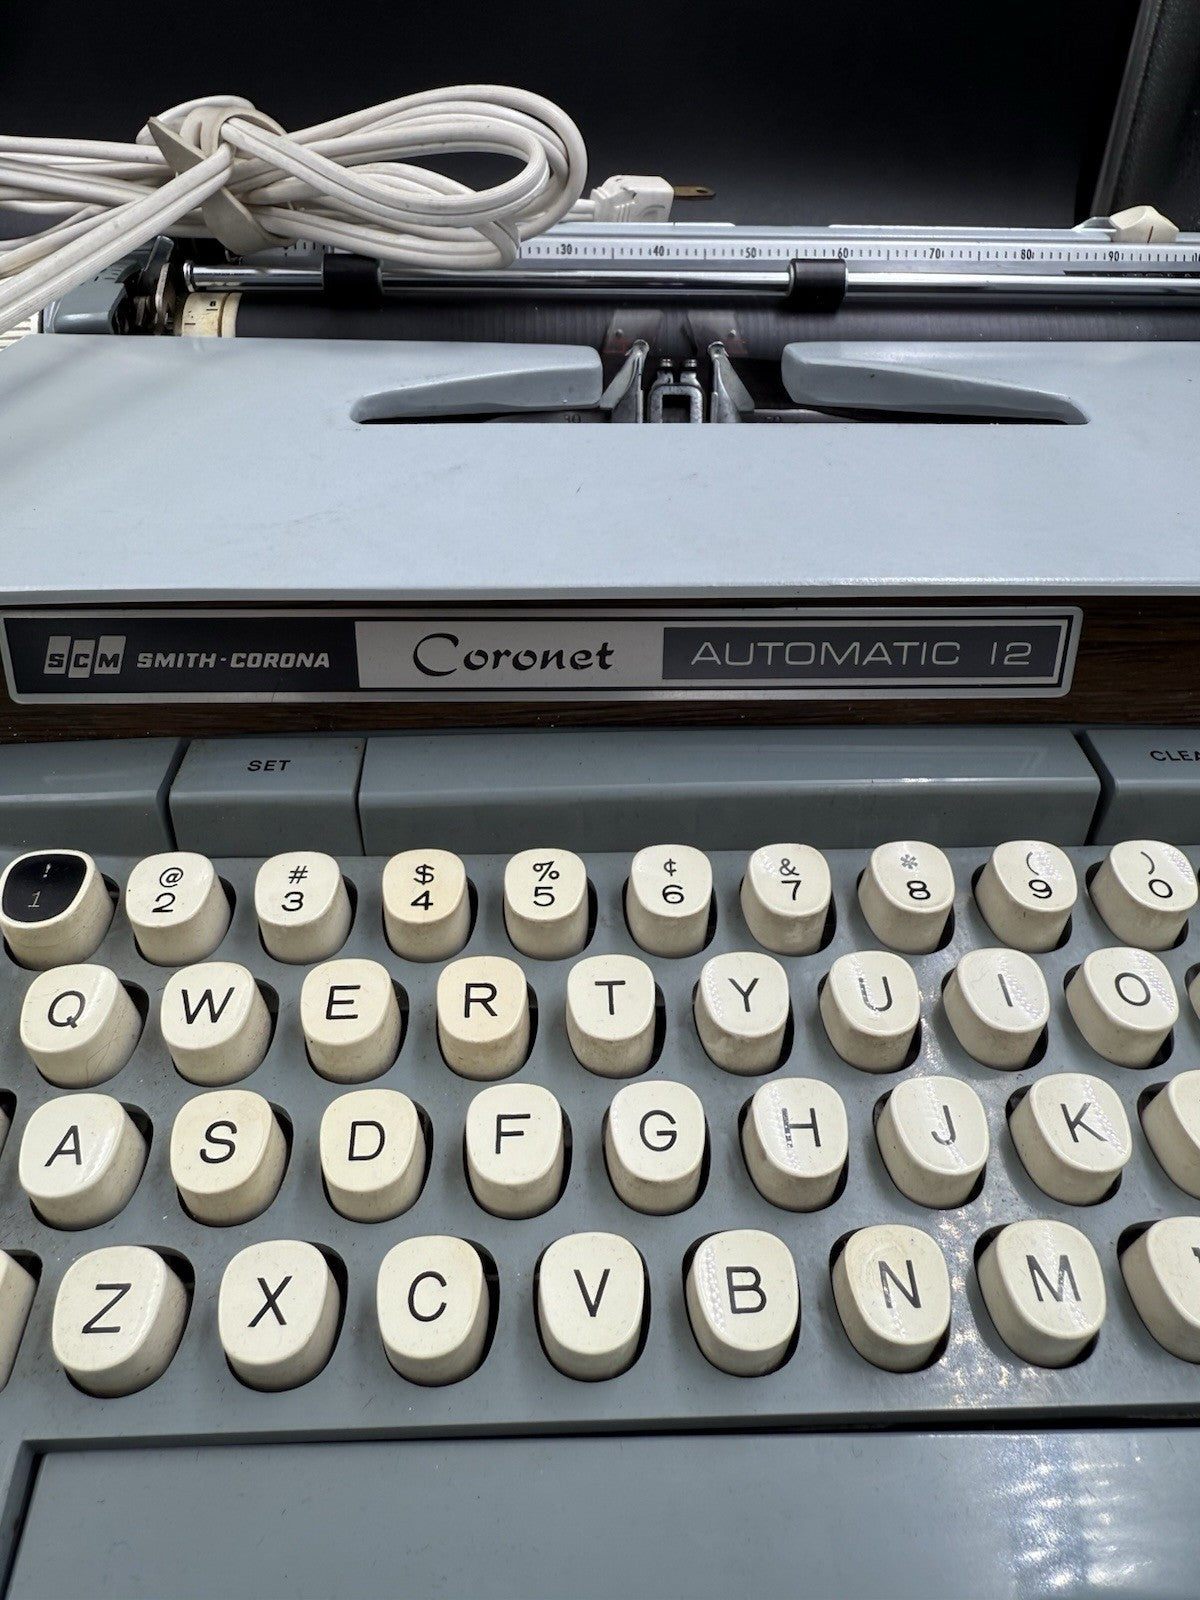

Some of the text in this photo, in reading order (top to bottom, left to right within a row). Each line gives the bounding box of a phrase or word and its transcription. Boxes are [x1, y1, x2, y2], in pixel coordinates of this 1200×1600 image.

[561, 243, 1119, 261] 30 40 50 60 70 80 90
[413, 633, 614, 676] Coronet
[691, 642, 1031, 665] AUTOMATIC 12
[247, 760, 291, 771] SET
[43, 864, 50, 877] !
[159, 867, 183, 888] @
[289, 866, 308, 884] #
[414, 864, 434, 885] $
[533, 861, 559, 881] %
[664, 859, 676, 876] ¢
[780, 859, 799, 876] &
[28, 891, 40, 907] 1
[152, 893, 175, 912] 2
[282, 892, 304, 911] 3
[411, 891, 433, 910] 4
[533, 887, 555, 906] 5
[662, 885, 684, 904] 6
[781, 880, 801, 900] 7
[907, 881, 931, 900] 8
[1029, 880, 1052, 899] 9
[182, 987, 234, 1024] W
[326, 985, 360, 1020] E
[464, 983, 497, 1018] R
[595, 980, 625, 1015] T
[729, 978, 758, 1012] Y
[859, 977, 892, 1011] U
[998, 974, 1013, 1007] I
[1115, 973, 1150, 1006] O
[48, 991, 85, 1028] Q
[496, 1114, 530, 1154] F
[640, 1110, 677, 1151] G
[782, 1108, 821, 1147] H
[931, 1105, 956, 1145] J
[1061, 1103, 1107, 1142] K
[45, 1126, 81, 1166] A
[200, 1121, 237, 1164] S
[348, 1121, 385, 1161] D
[574, 1269, 610, 1317] V
[726, 1267, 766, 1314] B
[879, 1260, 921, 1308] N
[1026, 1255, 1081, 1302] M
[82, 1283, 131, 1334] Z
[248, 1276, 292, 1327] X
[408, 1271, 446, 1322] C
